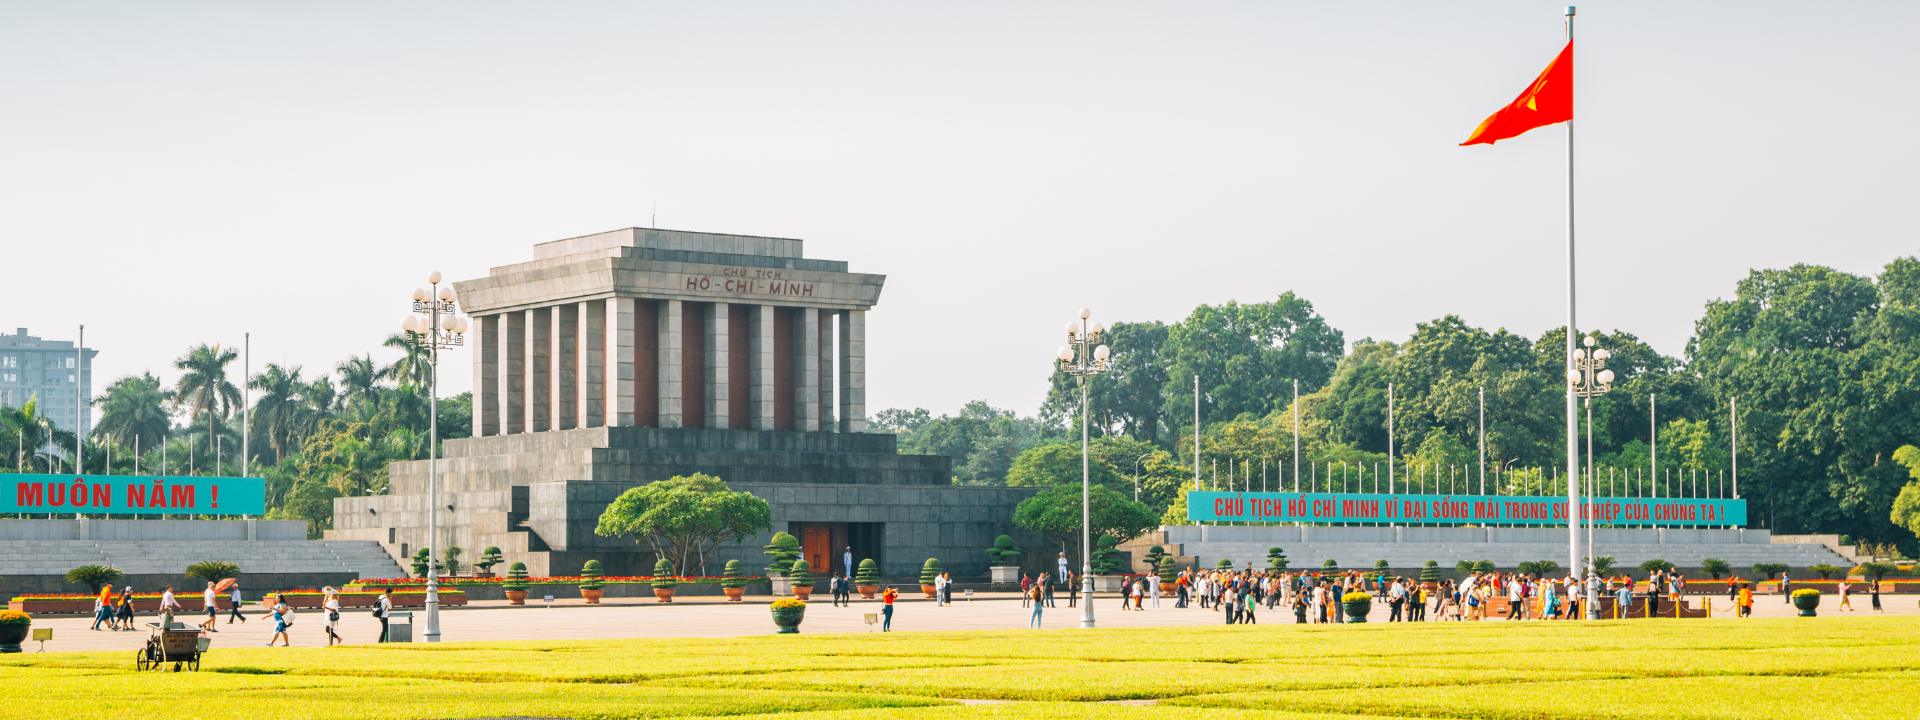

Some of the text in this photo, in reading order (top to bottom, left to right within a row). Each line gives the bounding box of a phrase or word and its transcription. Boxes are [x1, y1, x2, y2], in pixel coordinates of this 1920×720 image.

[17, 478, 111, 508] MUÔN
[127, 479, 195, 509] NĂM
[1215, 493, 1244, 517] CHỦ
[1250, 498, 1282, 520] TỊCH
[1313, 496, 1337, 518] CHÍ
[1343, 499, 1379, 518] MINH
[1386, 497, 1398, 518] VĨ
[1403, 500, 1427, 521] ĐẠI
[1433, 496, 1469, 519] SỐNG
[1474, 498, 1500, 519] MÃI
[1505, 501, 1548, 520] TRONG
[1552, 500, 1570, 522] SỰ
[1578, 499, 1621, 522] GHIỆP
[1625, 497, 1650, 520] CỦA
[1655, 498, 1696, 521] CHÚNG
[1701, 504, 1715, 521] TA
